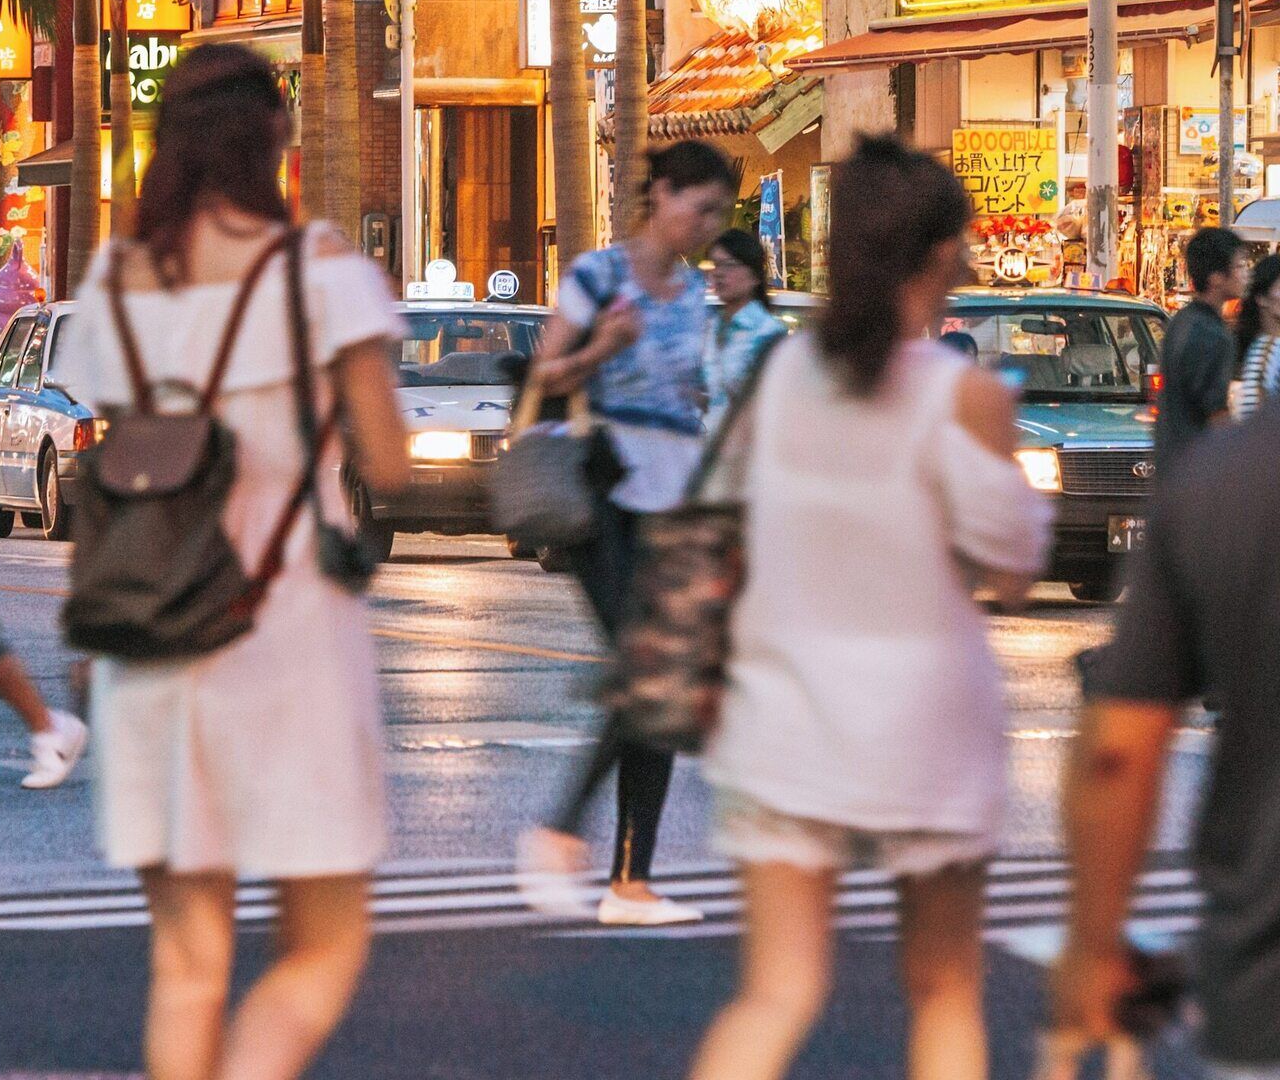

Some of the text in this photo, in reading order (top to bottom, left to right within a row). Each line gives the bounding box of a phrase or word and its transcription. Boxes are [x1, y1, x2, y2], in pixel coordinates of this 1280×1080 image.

[106, 37, 179, 71] ab
[954, 131, 1056, 152] 3000円以上
[954, 152, 1043, 173] お買い上げで
[970, 194, 1025, 214] レゼント
